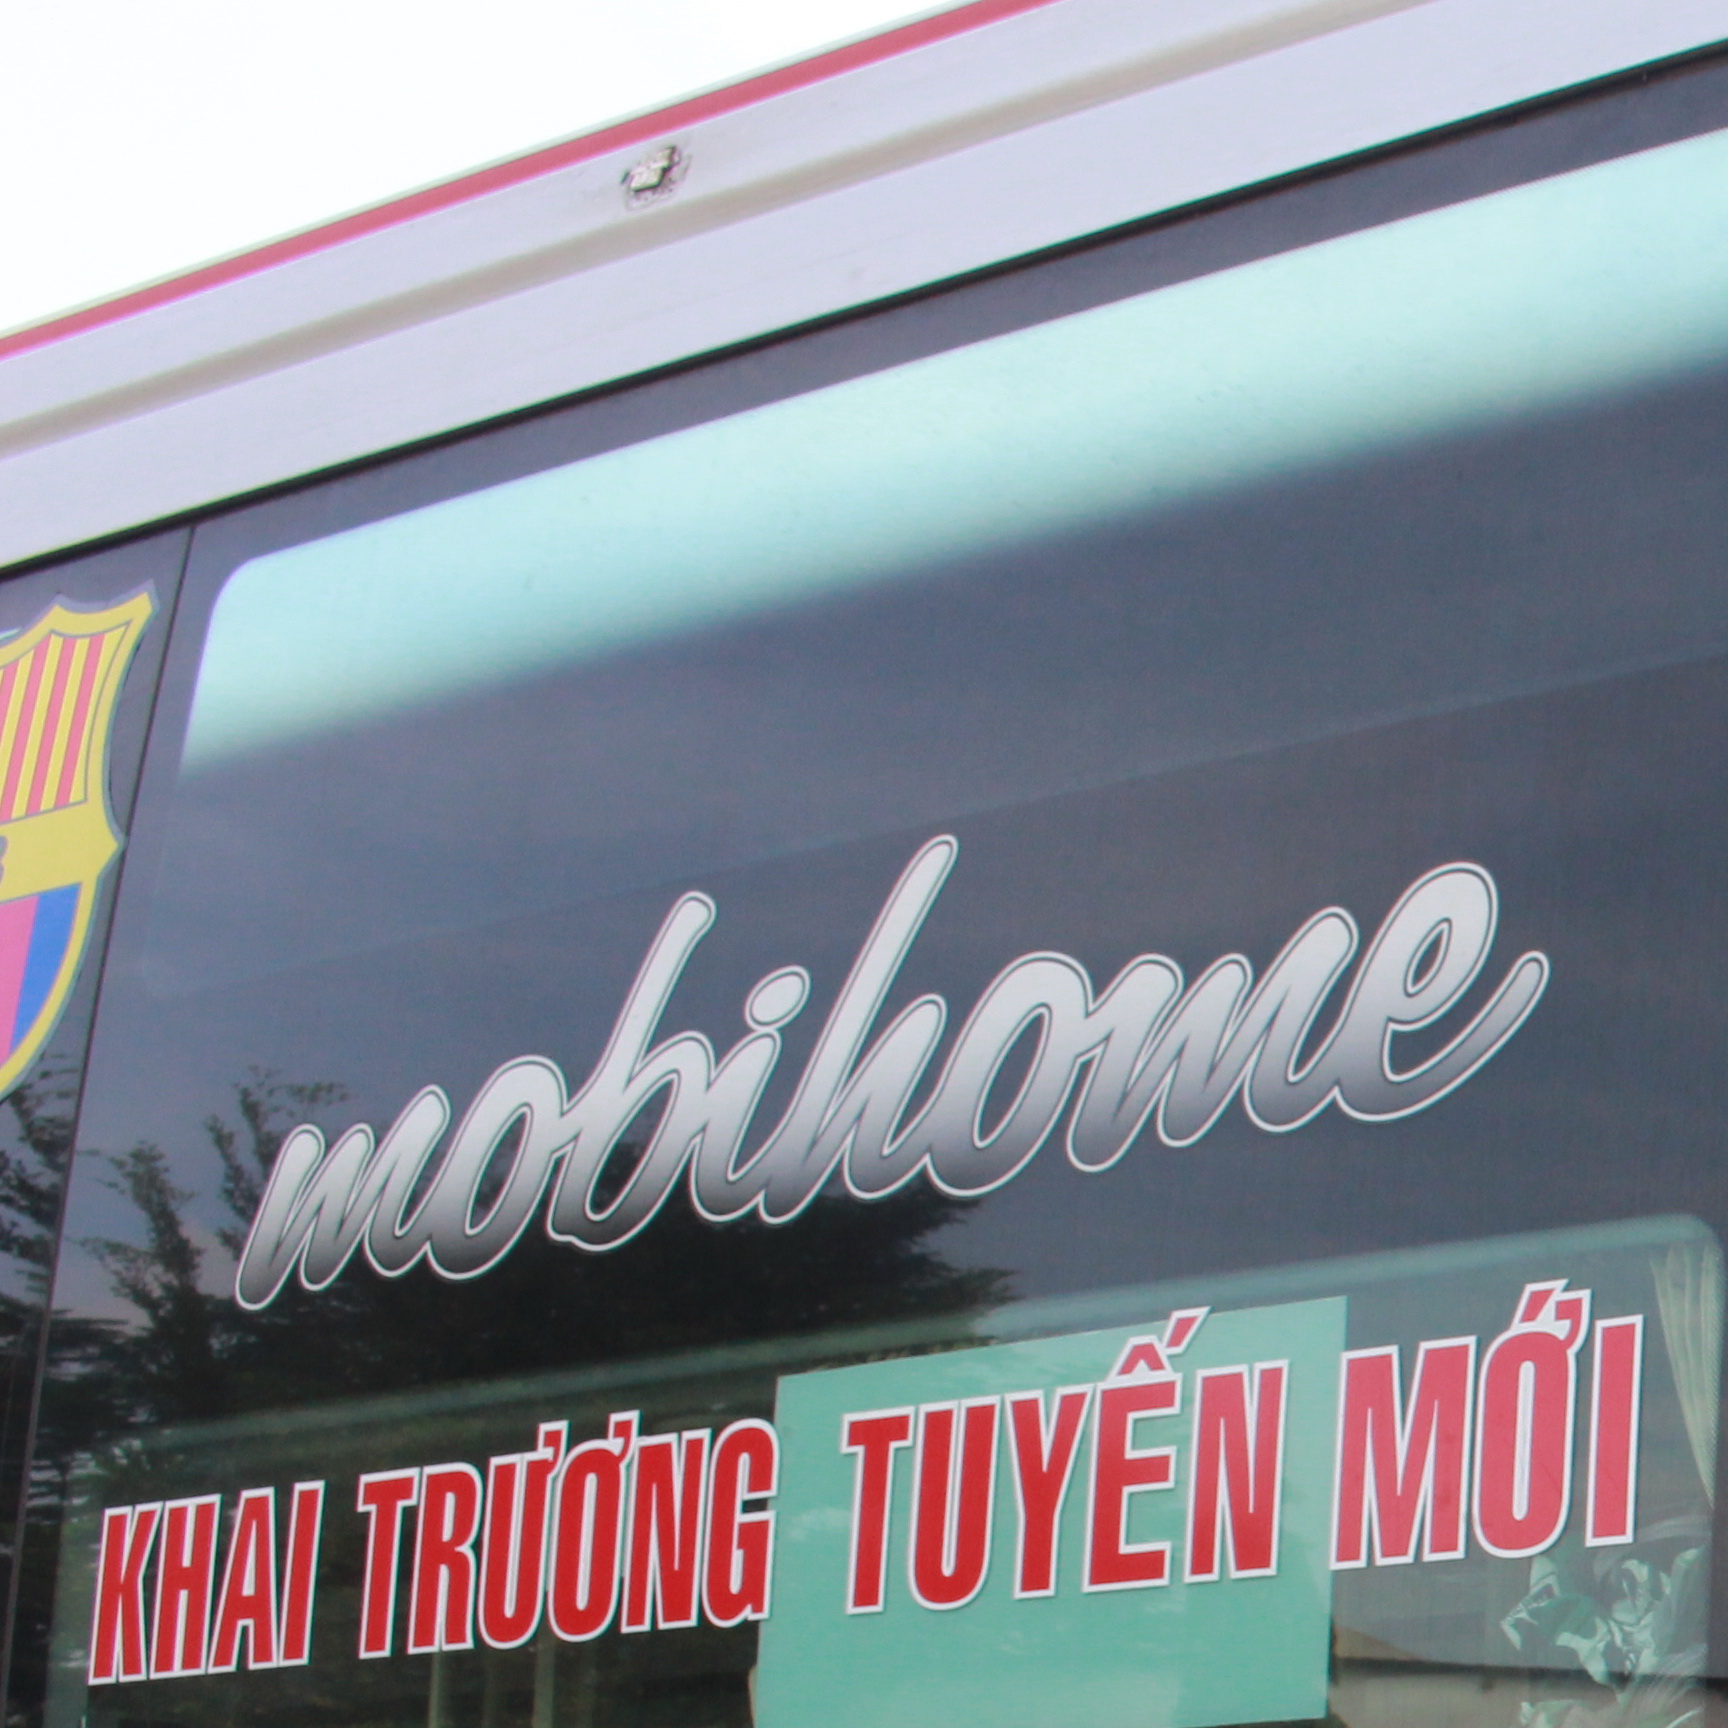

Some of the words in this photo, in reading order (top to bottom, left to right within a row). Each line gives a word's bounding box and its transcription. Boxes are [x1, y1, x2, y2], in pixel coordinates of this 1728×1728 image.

[236, 834, 1549, 1310] mobihome
[88, 1480, 325, 1686] KHAI
[357, 1409, 780, 1660] TRƯƠNG
[841, 1306, 1290, 1615] TUYẾN
[1330, 1279, 1643, 1571] MỚI
